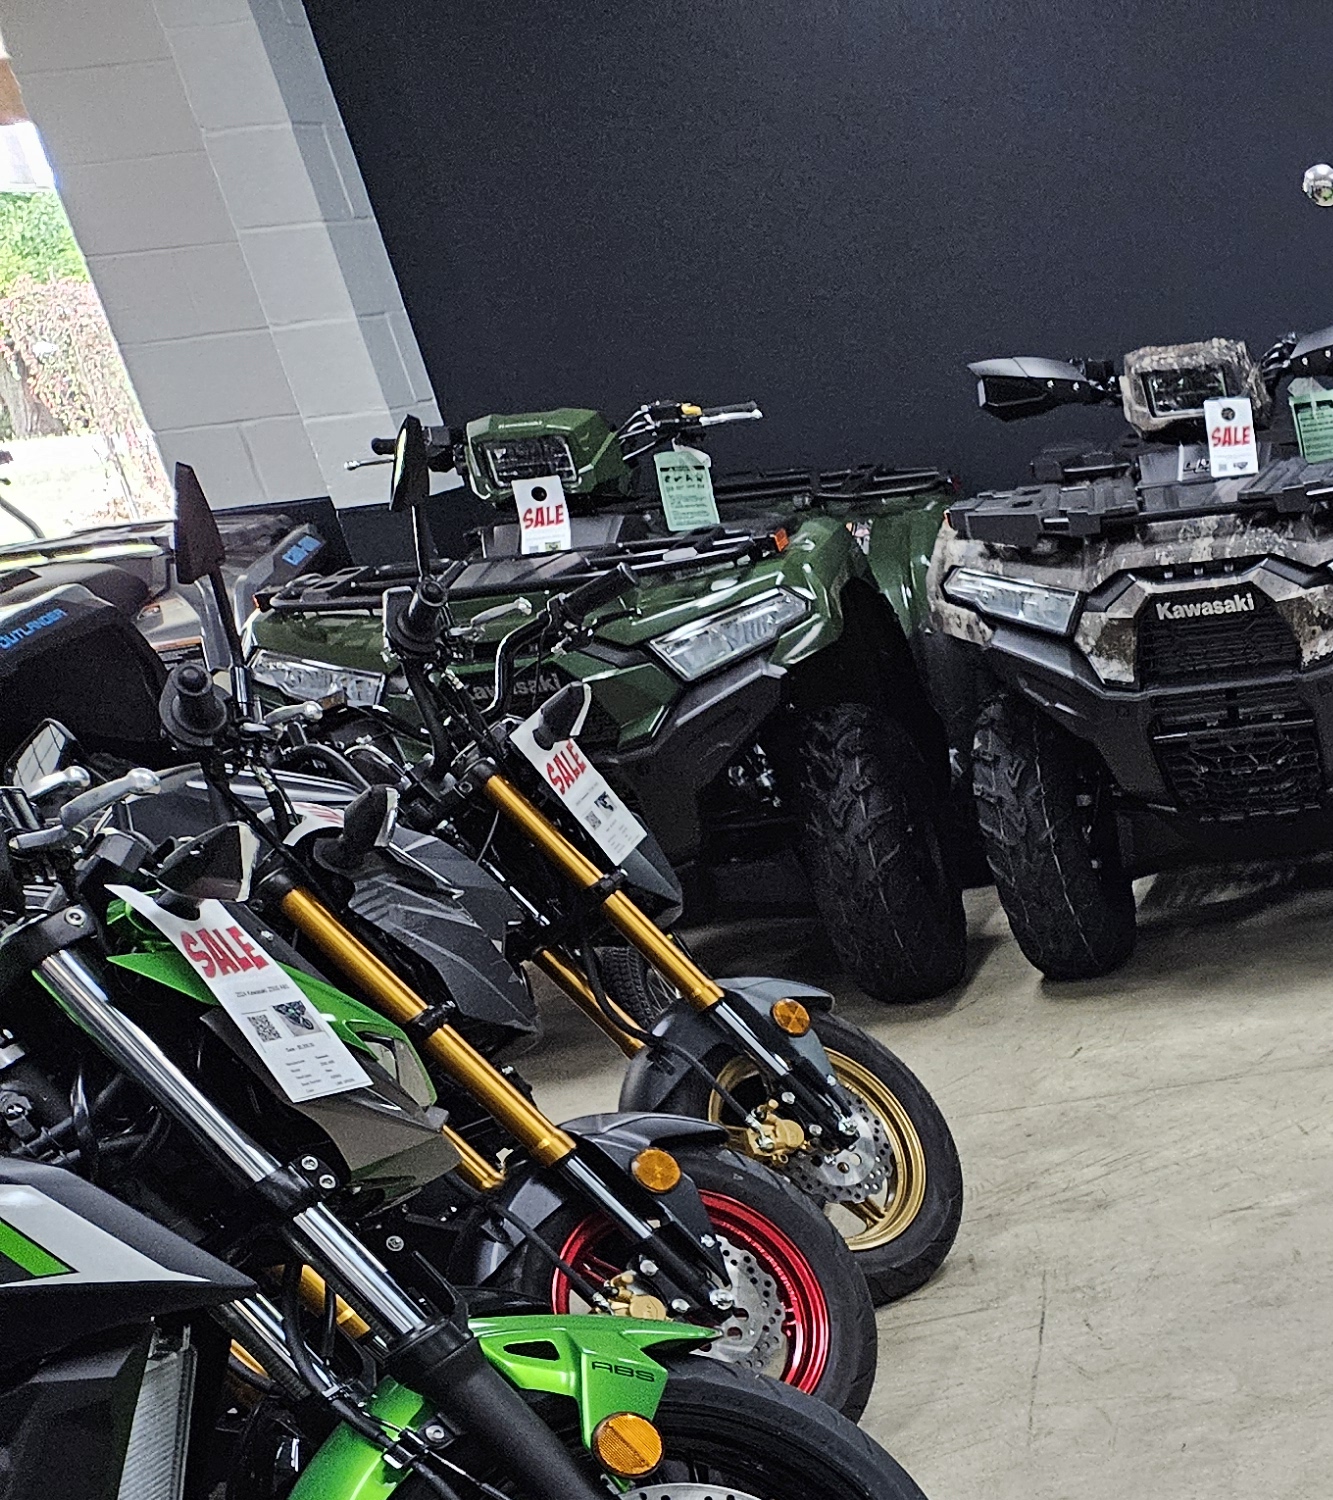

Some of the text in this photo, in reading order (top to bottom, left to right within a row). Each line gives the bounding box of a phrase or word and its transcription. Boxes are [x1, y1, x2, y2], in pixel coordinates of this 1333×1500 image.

[1211, 425, 1251, 447] SALE
[522, 503, 565, 529] SALE
[1156, 592, 1255, 621] Kawasaki
[546, 739, 587, 795] SALE
[180, 925, 269, 979] SALE
[592, 1361, 655, 1382] ABS
